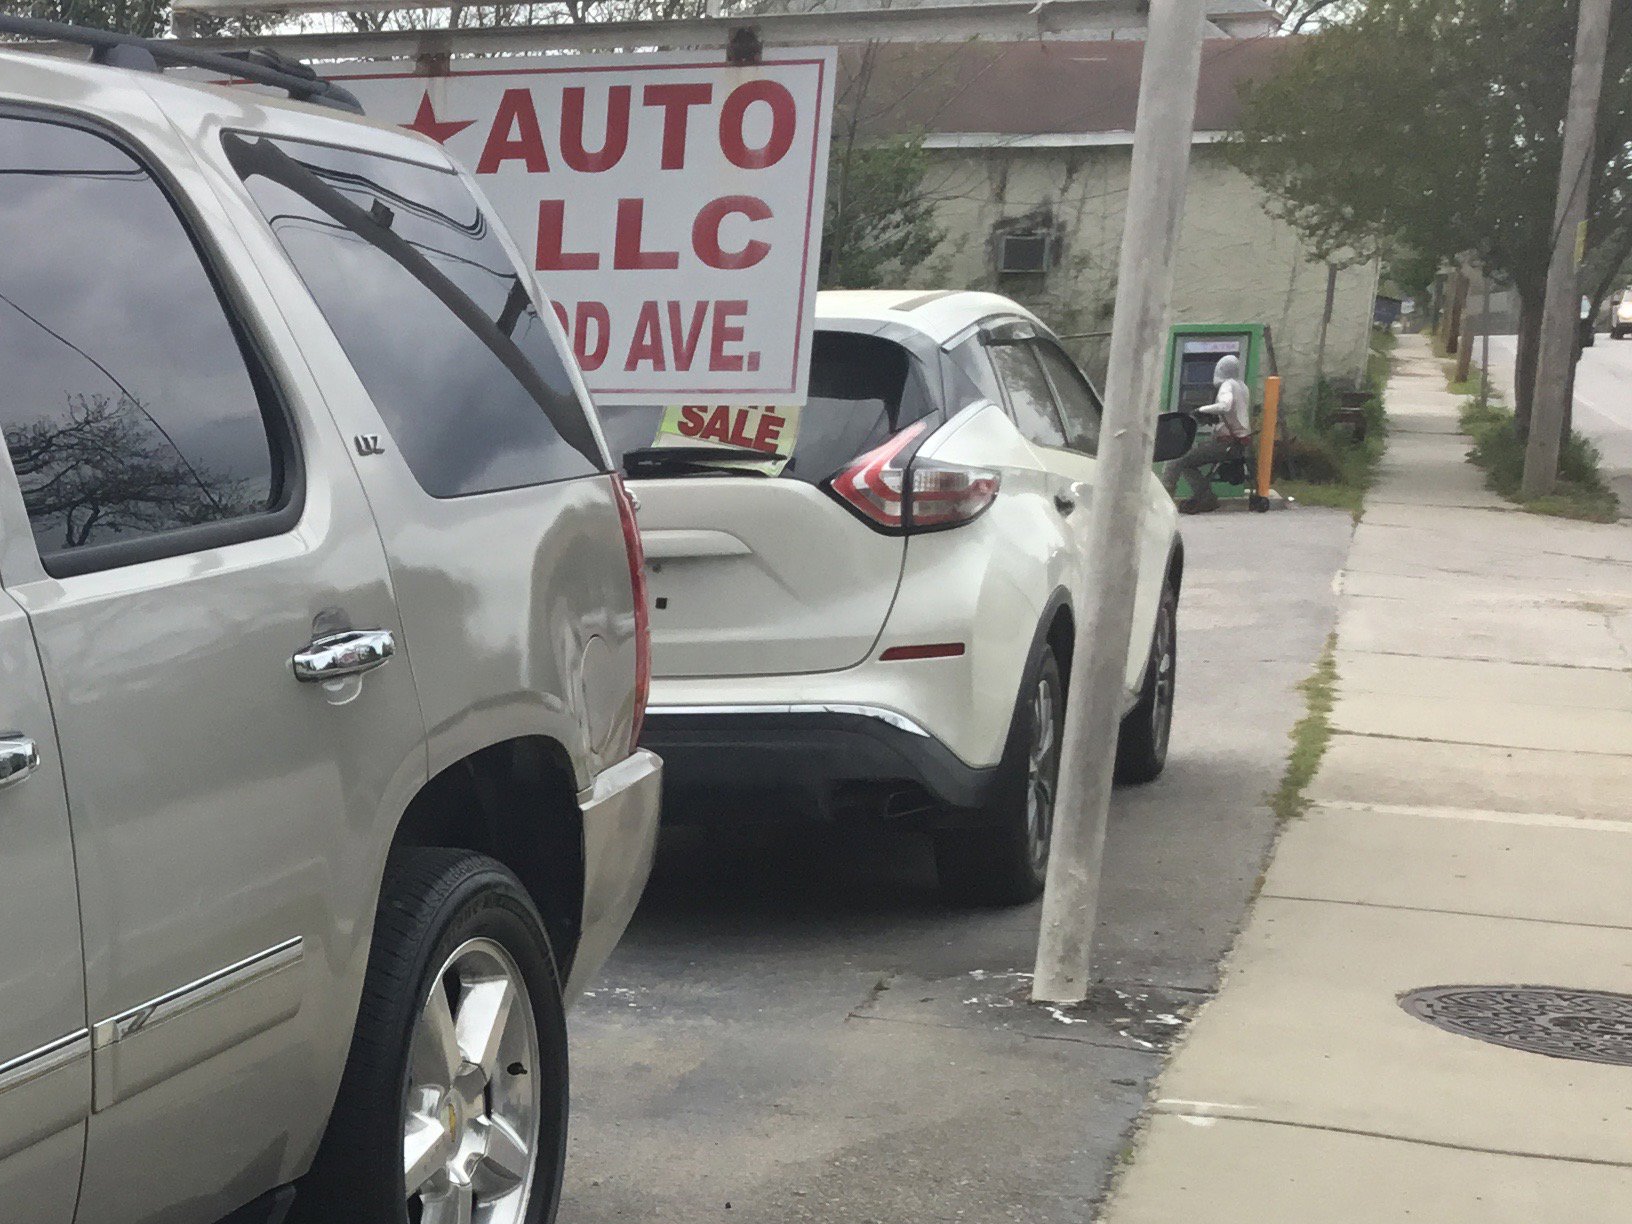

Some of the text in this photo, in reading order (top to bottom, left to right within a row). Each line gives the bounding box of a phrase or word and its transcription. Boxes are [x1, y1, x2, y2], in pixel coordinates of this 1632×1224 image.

[475, 80, 797, 174] AUTO
[535, 195, 773, 272] LLC
[624, 300, 761, 372] AVE.
[678, 405, 785, 454] SALE
